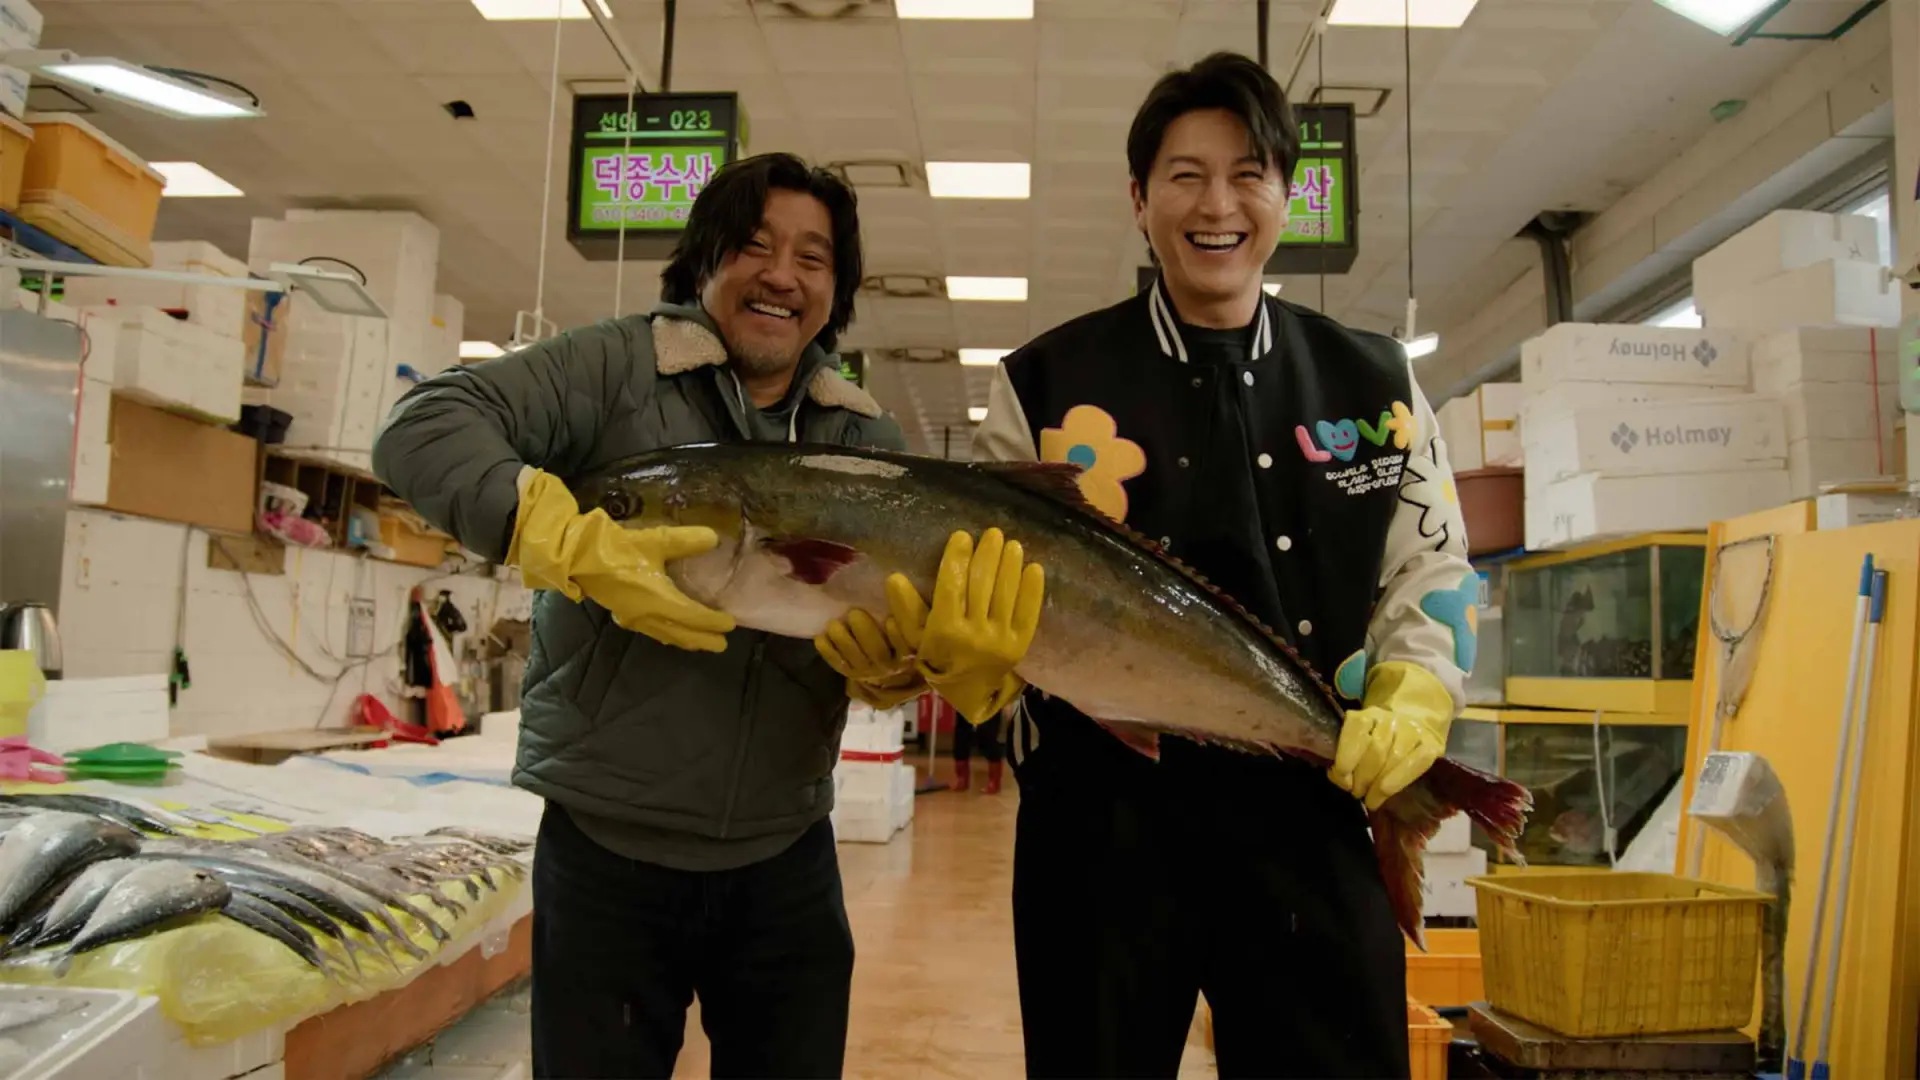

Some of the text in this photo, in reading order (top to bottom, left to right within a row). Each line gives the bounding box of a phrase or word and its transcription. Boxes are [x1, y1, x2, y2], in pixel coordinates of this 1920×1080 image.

[599, 111, 637, 132] 선어
[670, 110, 711, 130] 023
[592, 153, 716, 200] 덕종수산
